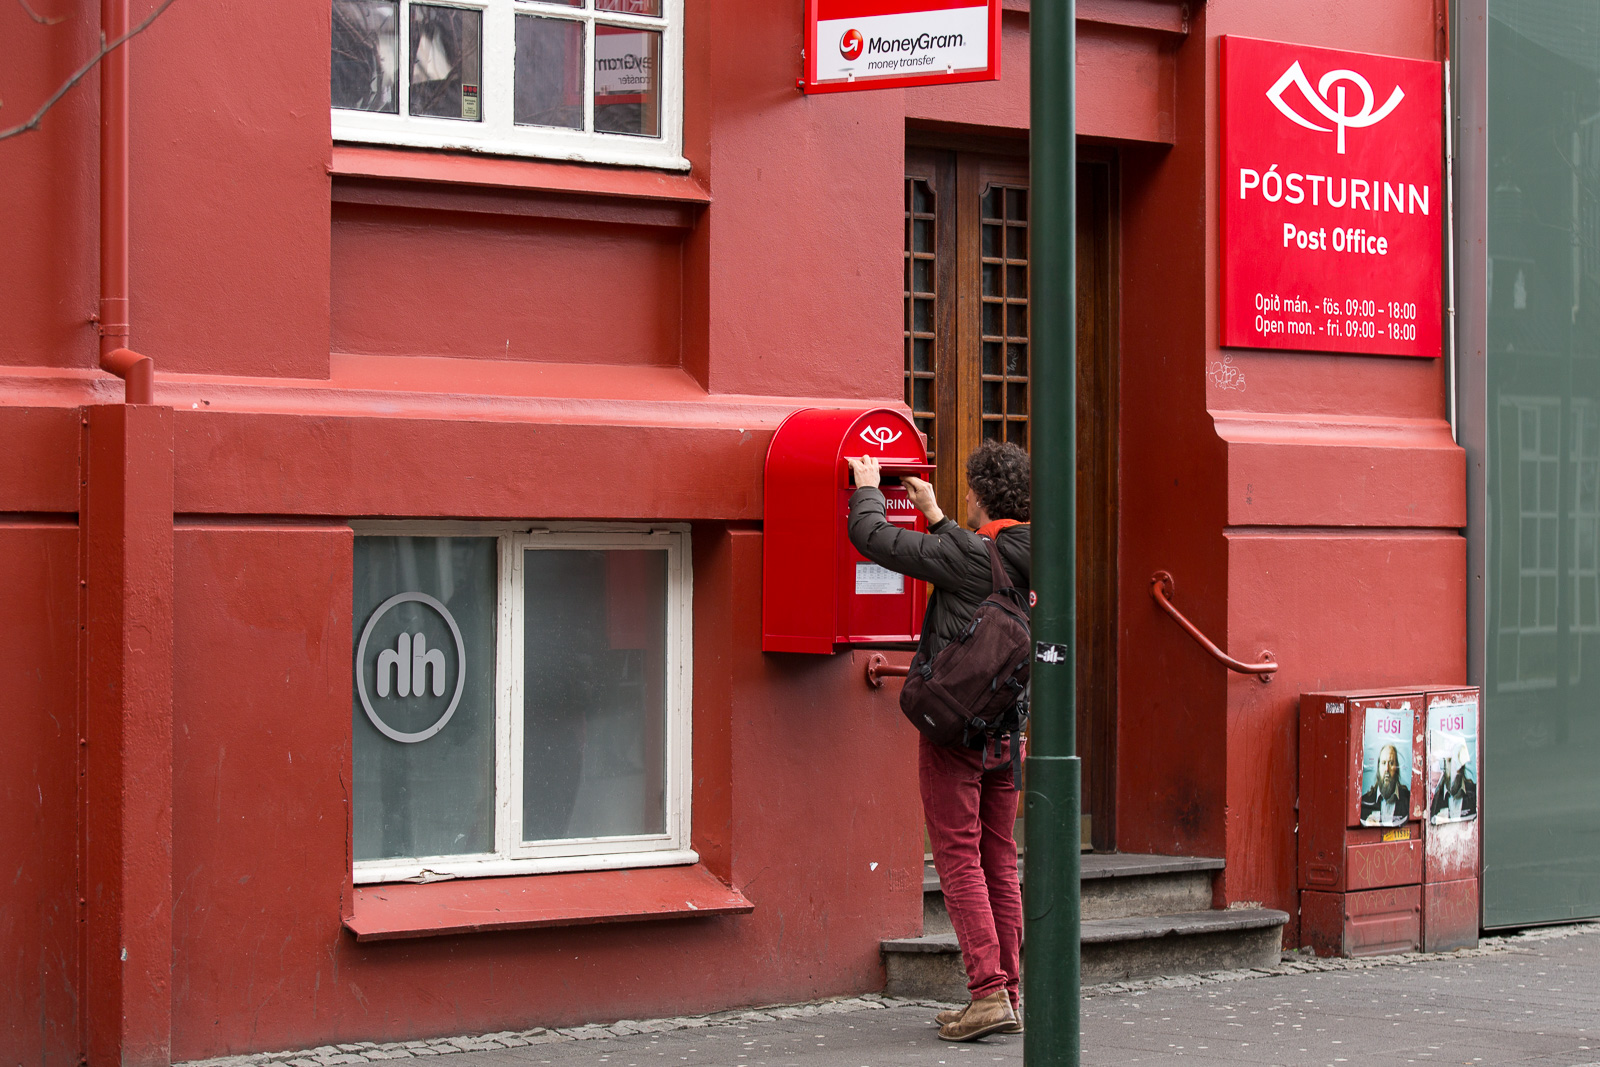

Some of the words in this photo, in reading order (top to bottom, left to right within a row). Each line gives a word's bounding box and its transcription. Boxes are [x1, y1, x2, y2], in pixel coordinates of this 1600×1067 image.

[868, 33, 963, 55] MoneyGram
[868, 60, 898, 70] money
[899, 54, 935, 67] transfer
[1240, 164, 1429, 215] PÓSTURINN
[1283, 223, 1326, 251] Post
[1332, 227, 1388, 255] Office
[1255, 293, 1280, 315] Opið
[1284, 295, 1311, 313] mán.
[1323, 297, 1342, 315] fös.
[1345, 299, 1375, 317] 09:00
[1388, 301, 1416, 320] 18:00
[1255, 315, 1284, 337] Open
[1287, 321, 1315, 335] mon.
[1327, 319, 1343, 336] fri.
[1345, 320, 1375, 338] 09:00
[1388, 322, 1416, 340] 18:00
[886, 499, 915, 510] RINN
[1377, 716, 1401, 734] FÚSI
[1440, 714, 1464, 732] FÚSI
